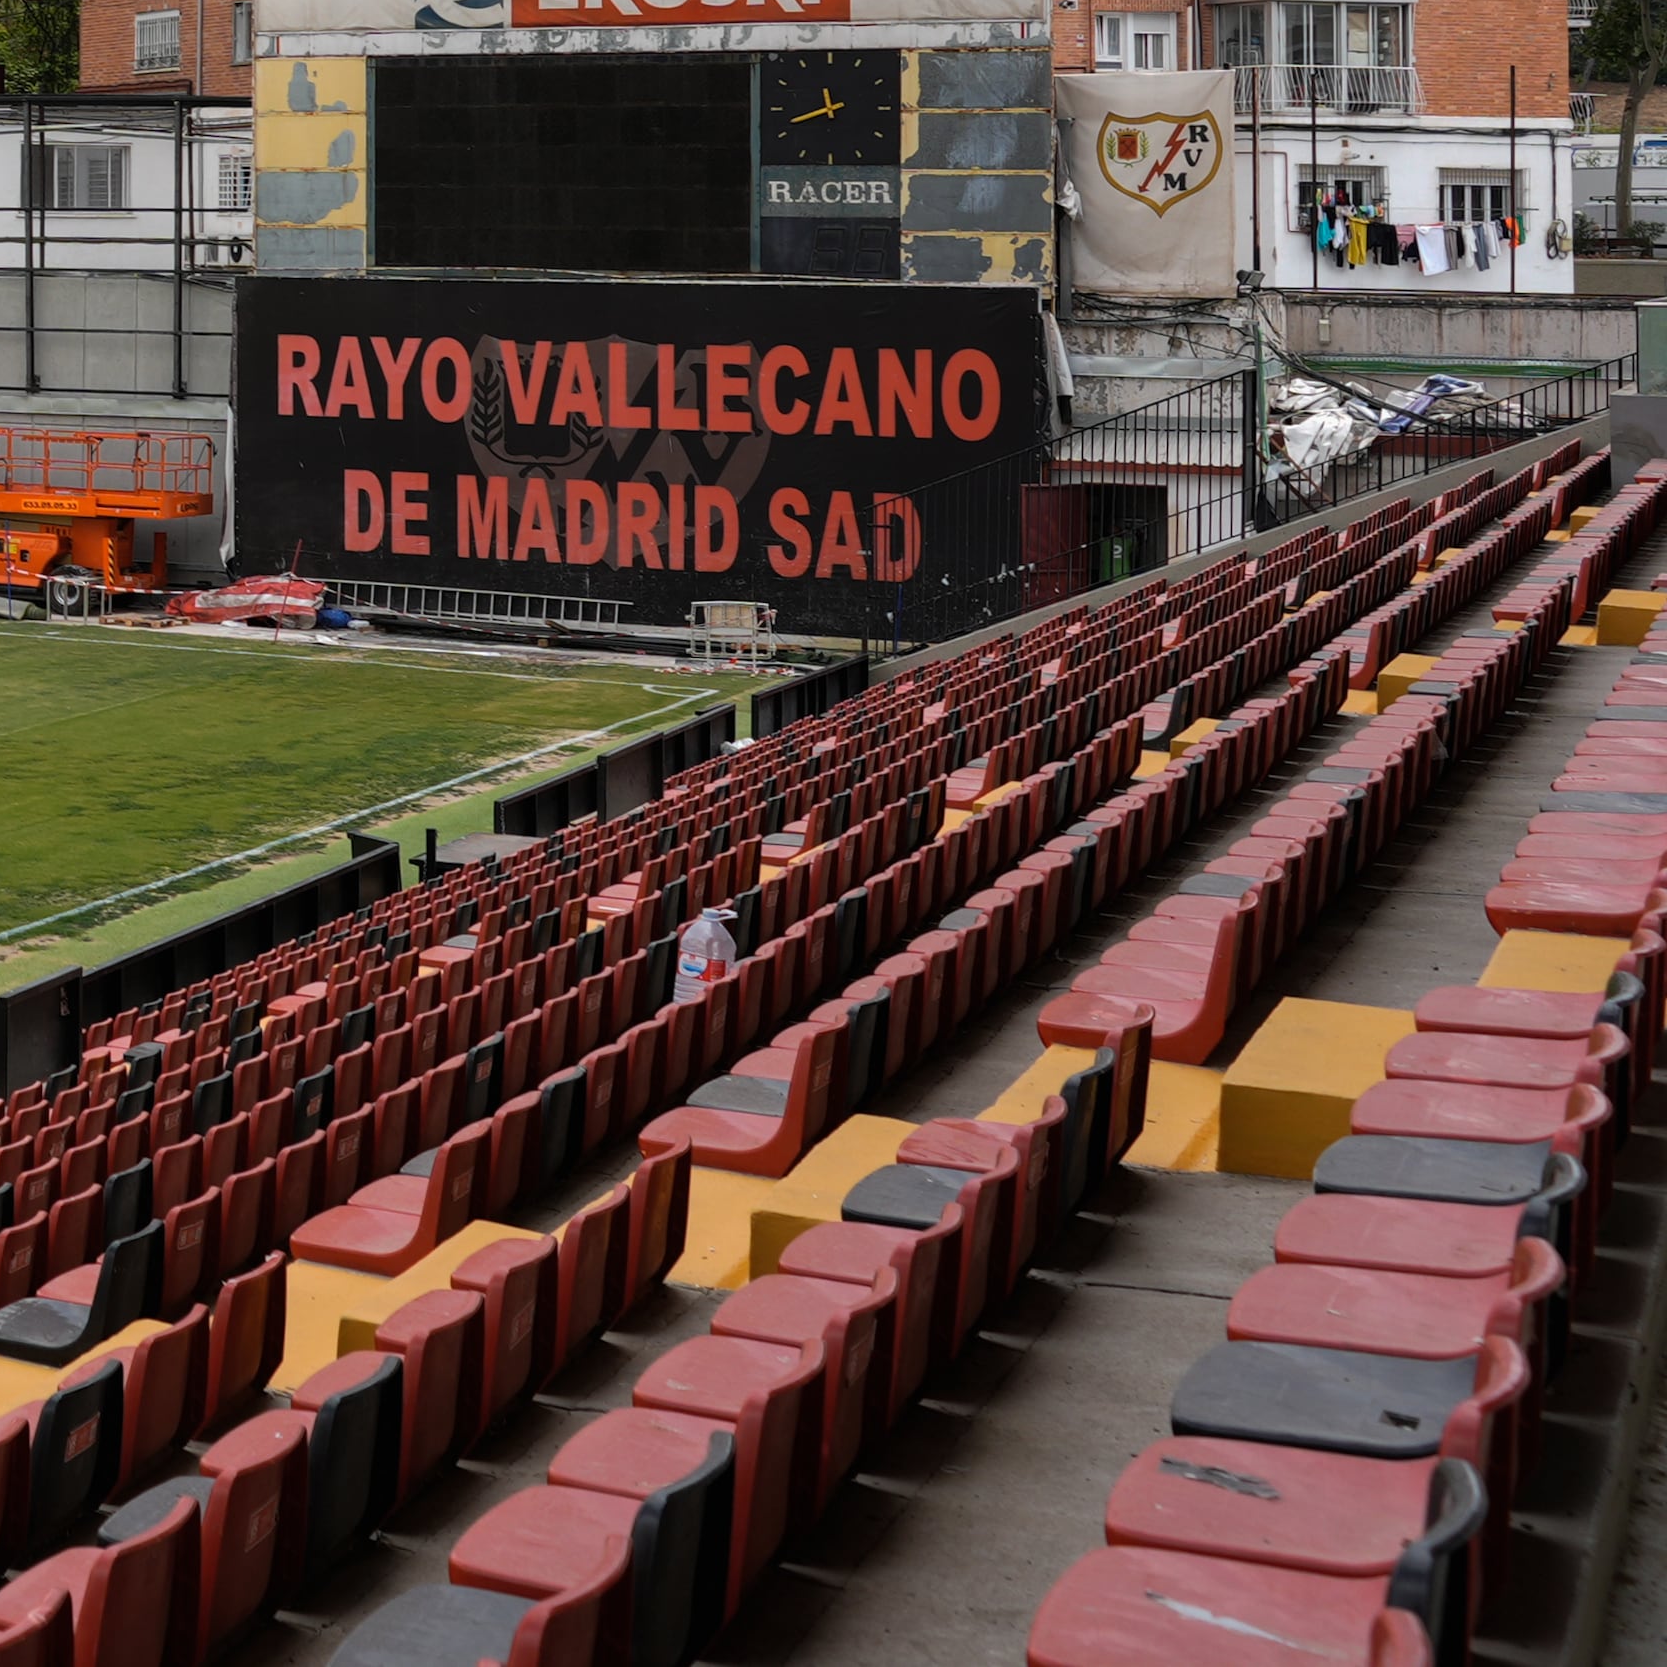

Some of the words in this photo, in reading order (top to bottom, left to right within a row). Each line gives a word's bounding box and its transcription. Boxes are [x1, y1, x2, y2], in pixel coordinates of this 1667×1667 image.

[1188, 124, 1210, 143] R
[1184, 149, 1203, 167] V
[768, 180, 893, 204] RACER
[1163, 172, 1187, 191] M
[278, 334, 473, 424] RAYO
[499, 339, 1001, 442] VALLECANO
[344, 469, 431, 555] DE
[457, 474, 740, 572] MADRID
[768, 487, 921, 583] SAD
